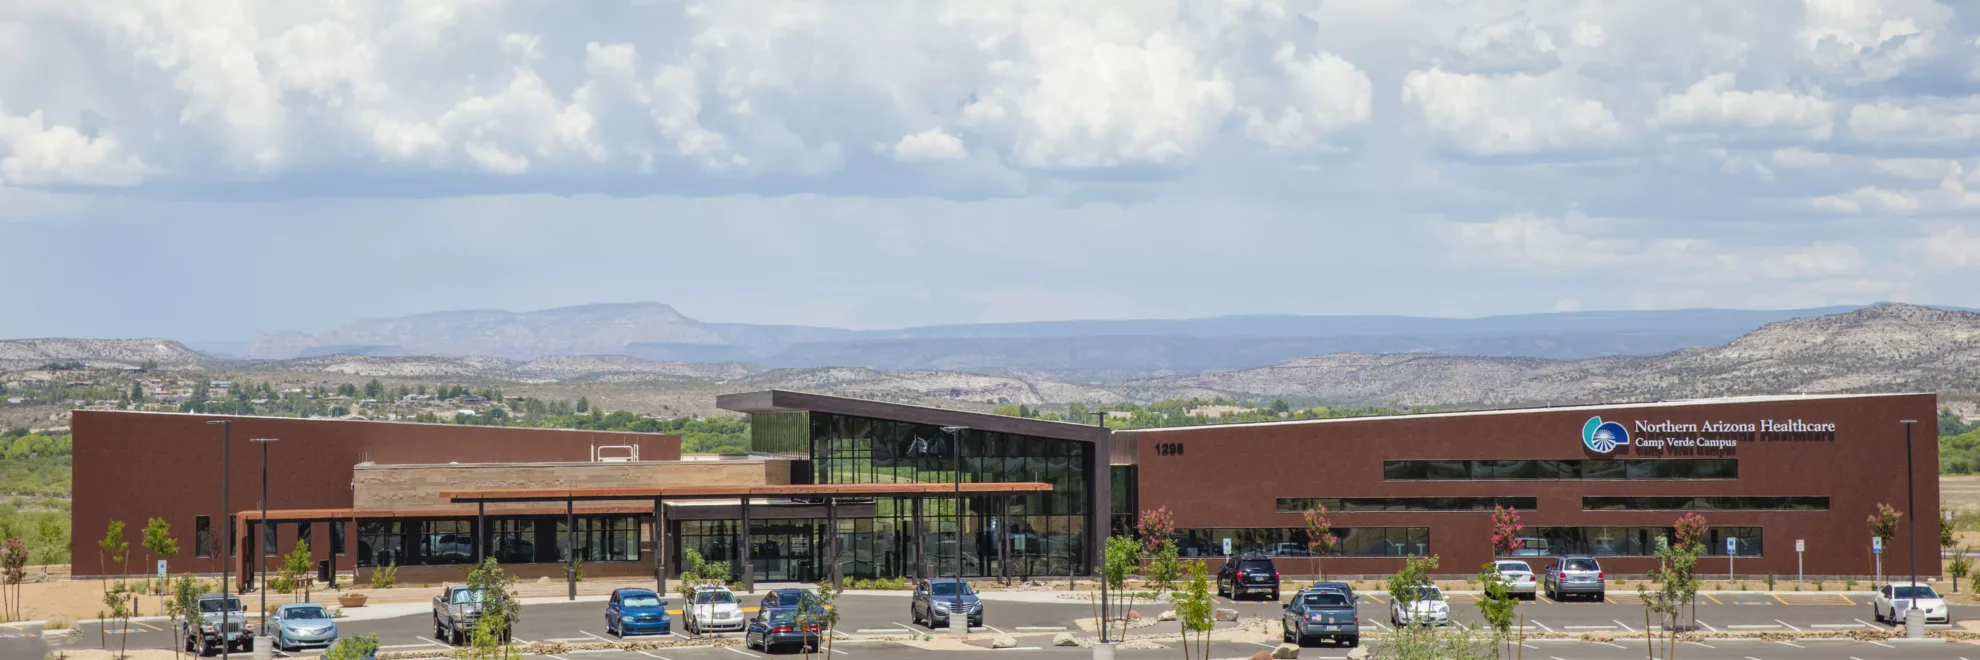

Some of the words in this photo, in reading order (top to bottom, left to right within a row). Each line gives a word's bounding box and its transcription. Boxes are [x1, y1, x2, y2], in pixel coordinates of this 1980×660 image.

[1635, 420, 1697, 432] Northern
[1702, 420, 1755, 432] Arizona
[1760, 419, 1835, 432] Healthcare
[1635, 438, 1664, 449] Camp
[1666, 437, 1694, 447] Verde
[1697, 438, 1736, 449] Campus
